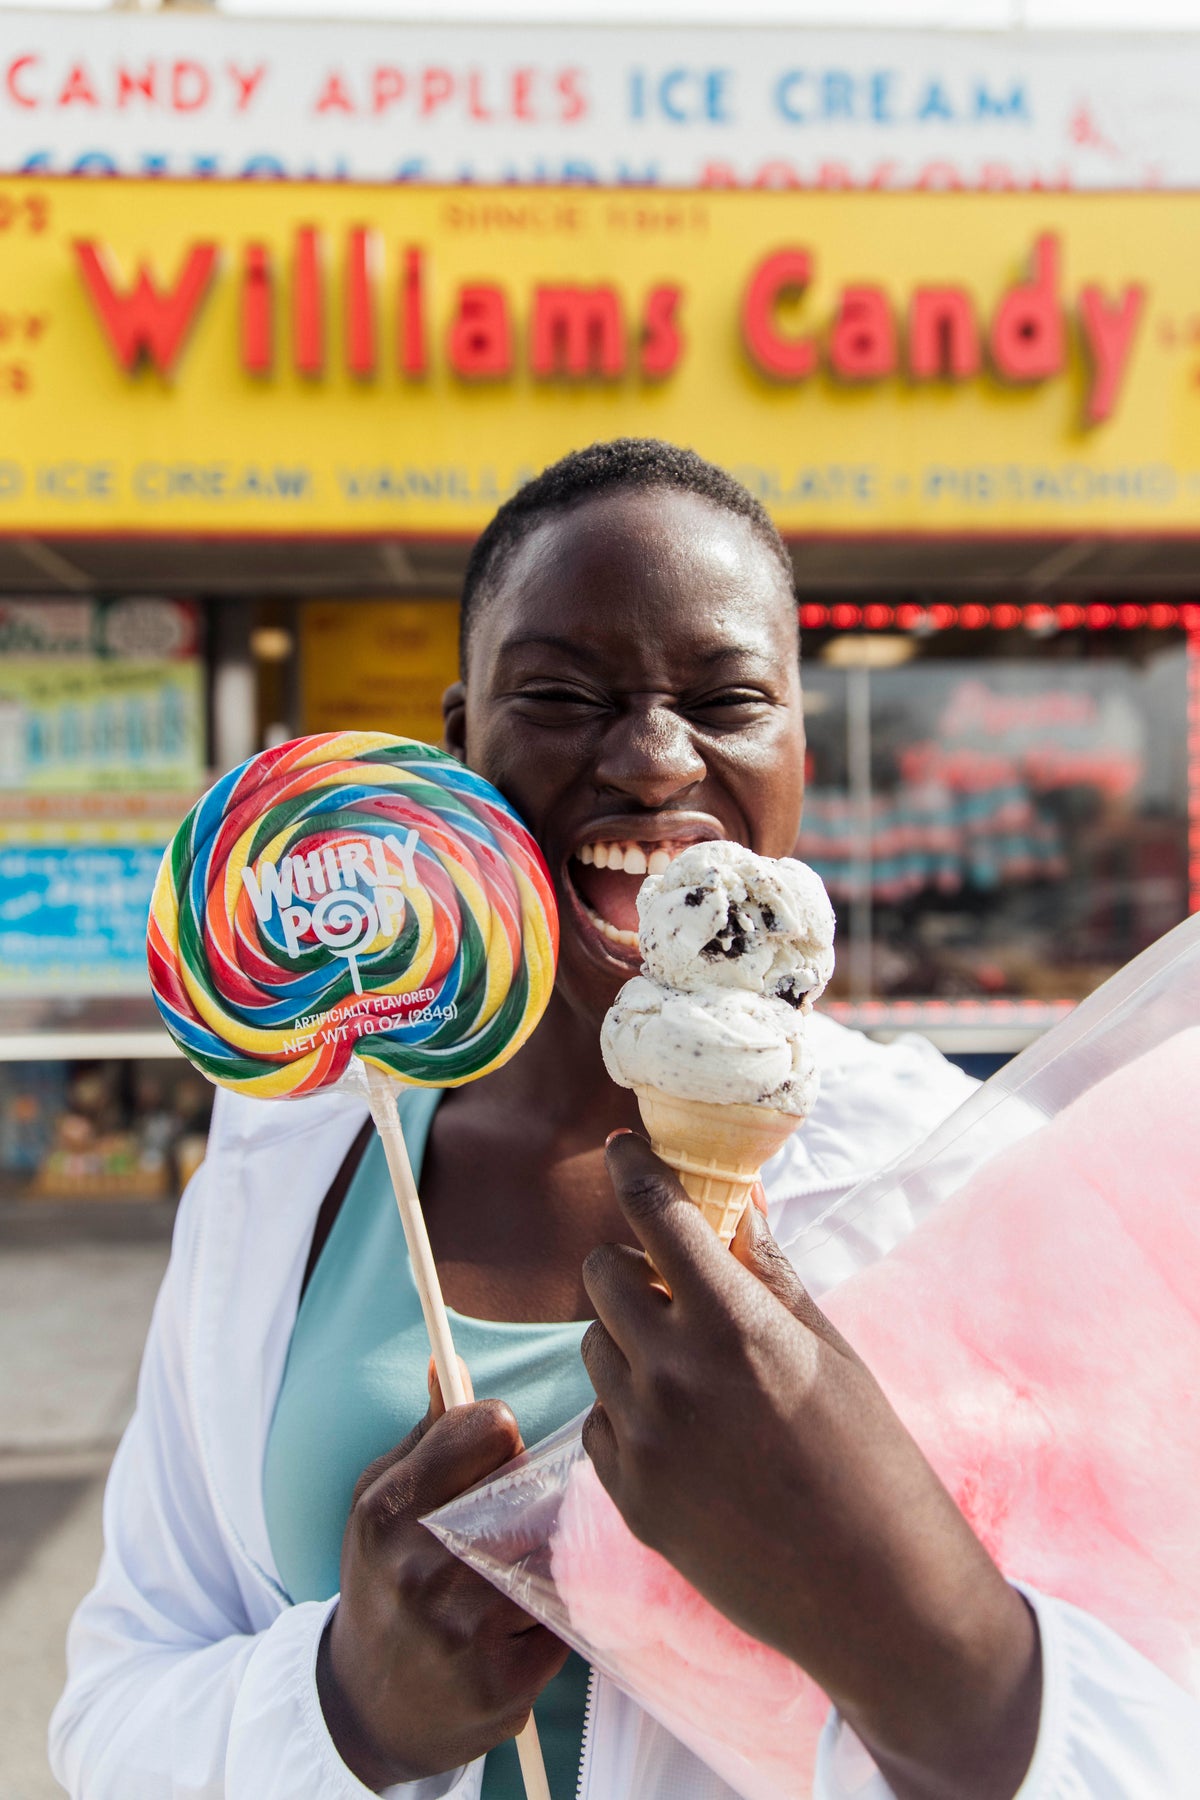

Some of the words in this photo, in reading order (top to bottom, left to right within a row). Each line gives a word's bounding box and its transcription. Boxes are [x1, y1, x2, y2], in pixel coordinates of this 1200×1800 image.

[4, 53, 268, 113] CANDY
[312, 63, 592, 122] APPLES
[628, 68, 734, 124] ICE
[771, 68, 1034, 124] CREAM
[70, 224, 684, 384] Williams
[742, 228, 1146, 424] Candy
[36, 460, 119, 505] ICE
[921, 461, 1181, 510] PISTACHIO
[240, 829, 420, 922] WHIRLY
[281, 886, 406, 960] POP
[282, 1032, 318, 1056] NET
[322, 1025, 350, 1046] WT
[353, 1018, 375, 1037] 10
[378, 1012, 404, 1031] OZ
[408, 1001, 458, 1029] (284g)
[294, 1002, 371, 1031] ARTIFICIALLY
[373, 987, 436, 1010] FLAVORED
